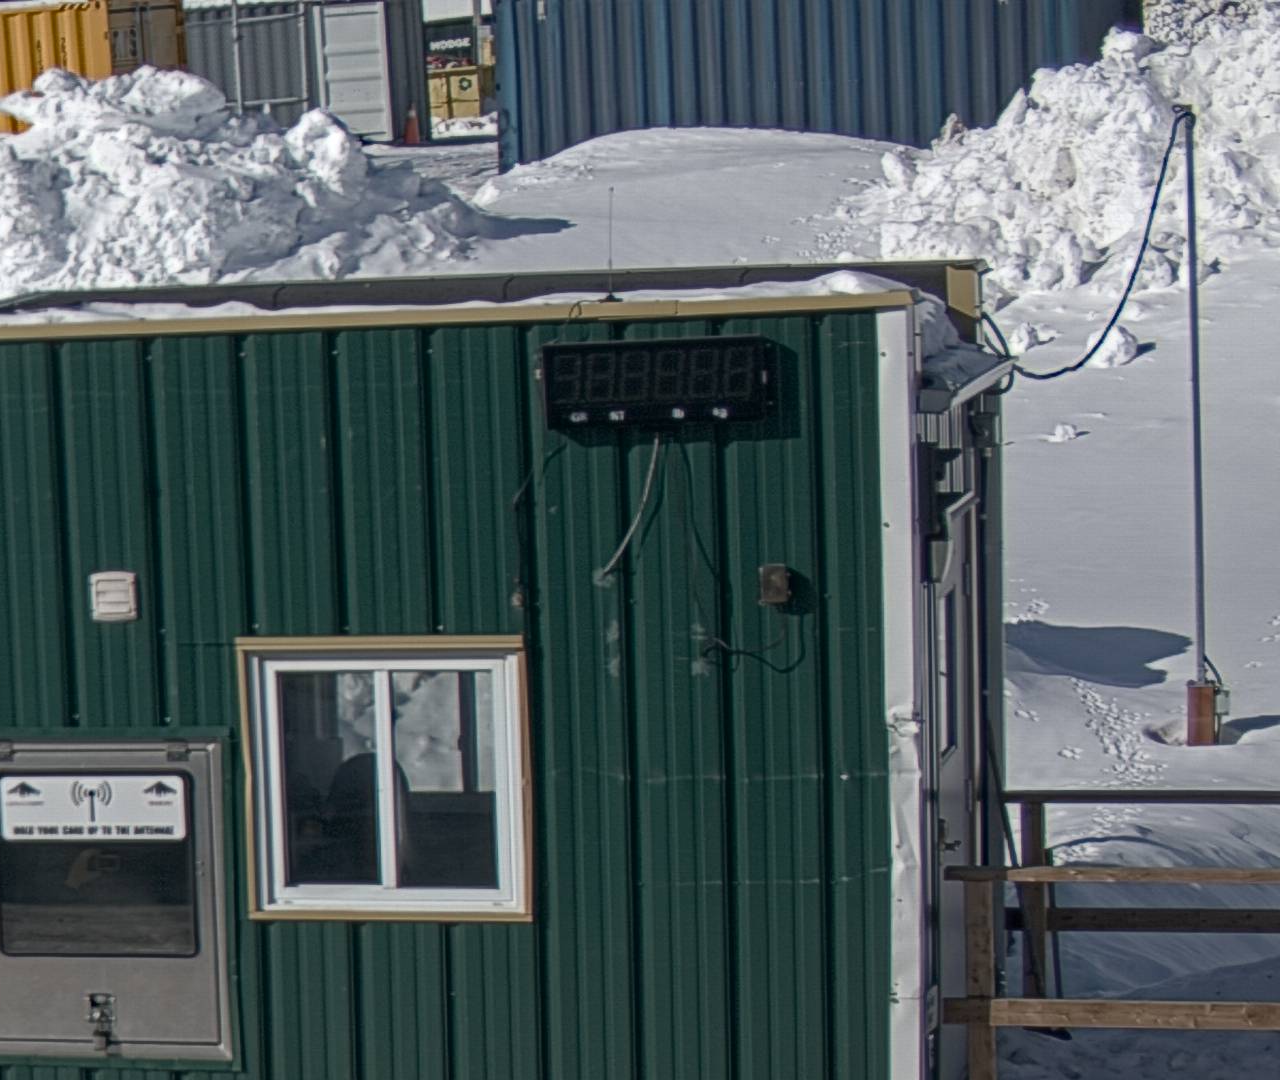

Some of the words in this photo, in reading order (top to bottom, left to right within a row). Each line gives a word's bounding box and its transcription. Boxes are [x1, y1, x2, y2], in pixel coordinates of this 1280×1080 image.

[37, 825, 59, 836] YOUR
[62, 825, 85, 836] CARD
[87, 825, 99, 836] UP
[101, 825, 113, 836] TO
[114, 825, 130, 836] THE
